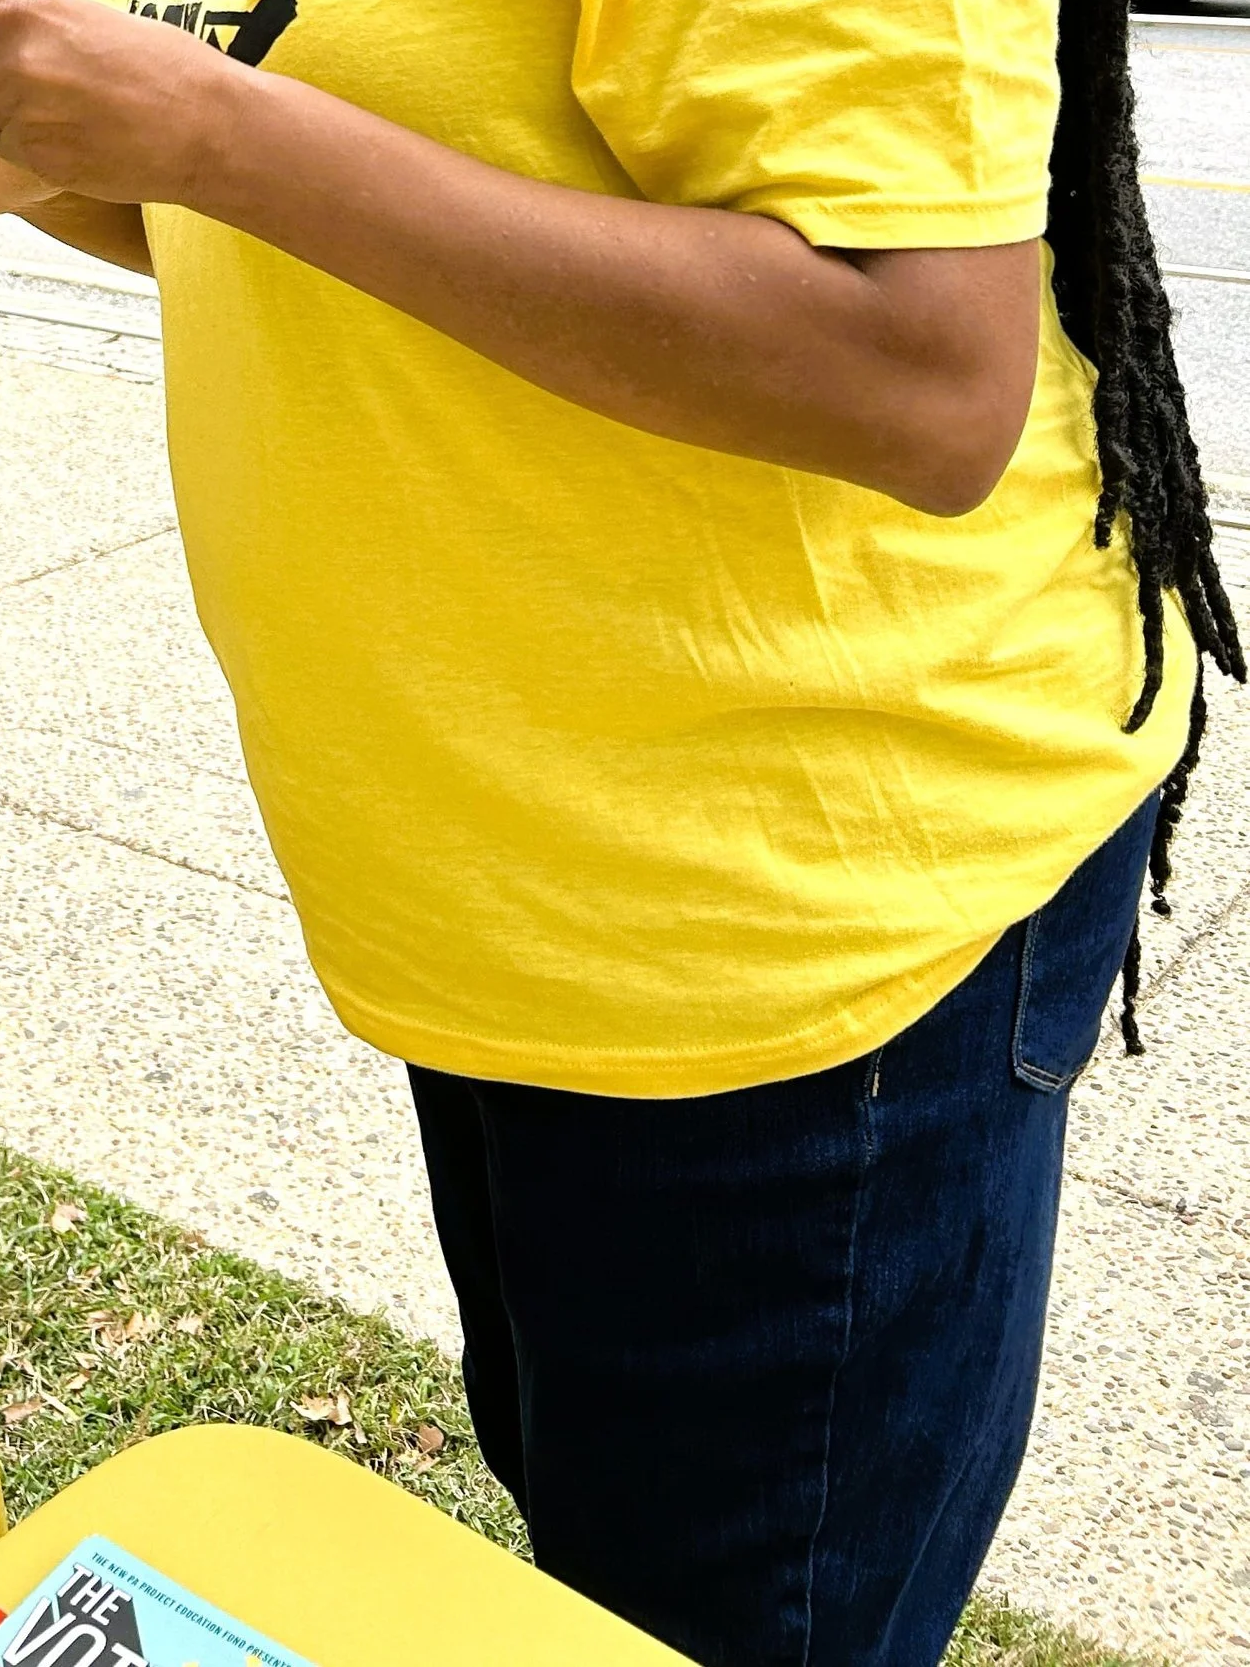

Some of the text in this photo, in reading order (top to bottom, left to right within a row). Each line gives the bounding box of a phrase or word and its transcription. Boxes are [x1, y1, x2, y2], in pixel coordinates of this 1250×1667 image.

[56, 1562, 134, 1627] THE
[91, 1551, 109, 1568] THE
[108, 1562, 129, 1580] NEW
[126, 1575, 141, 1588] PA
[140, 1582, 176, 1609] PROJECT
[175, 1603, 223, 1637] EDUCATION
[222, 1630, 247, 1650] FUND
[2, 1596, 151, 1667] VOT
